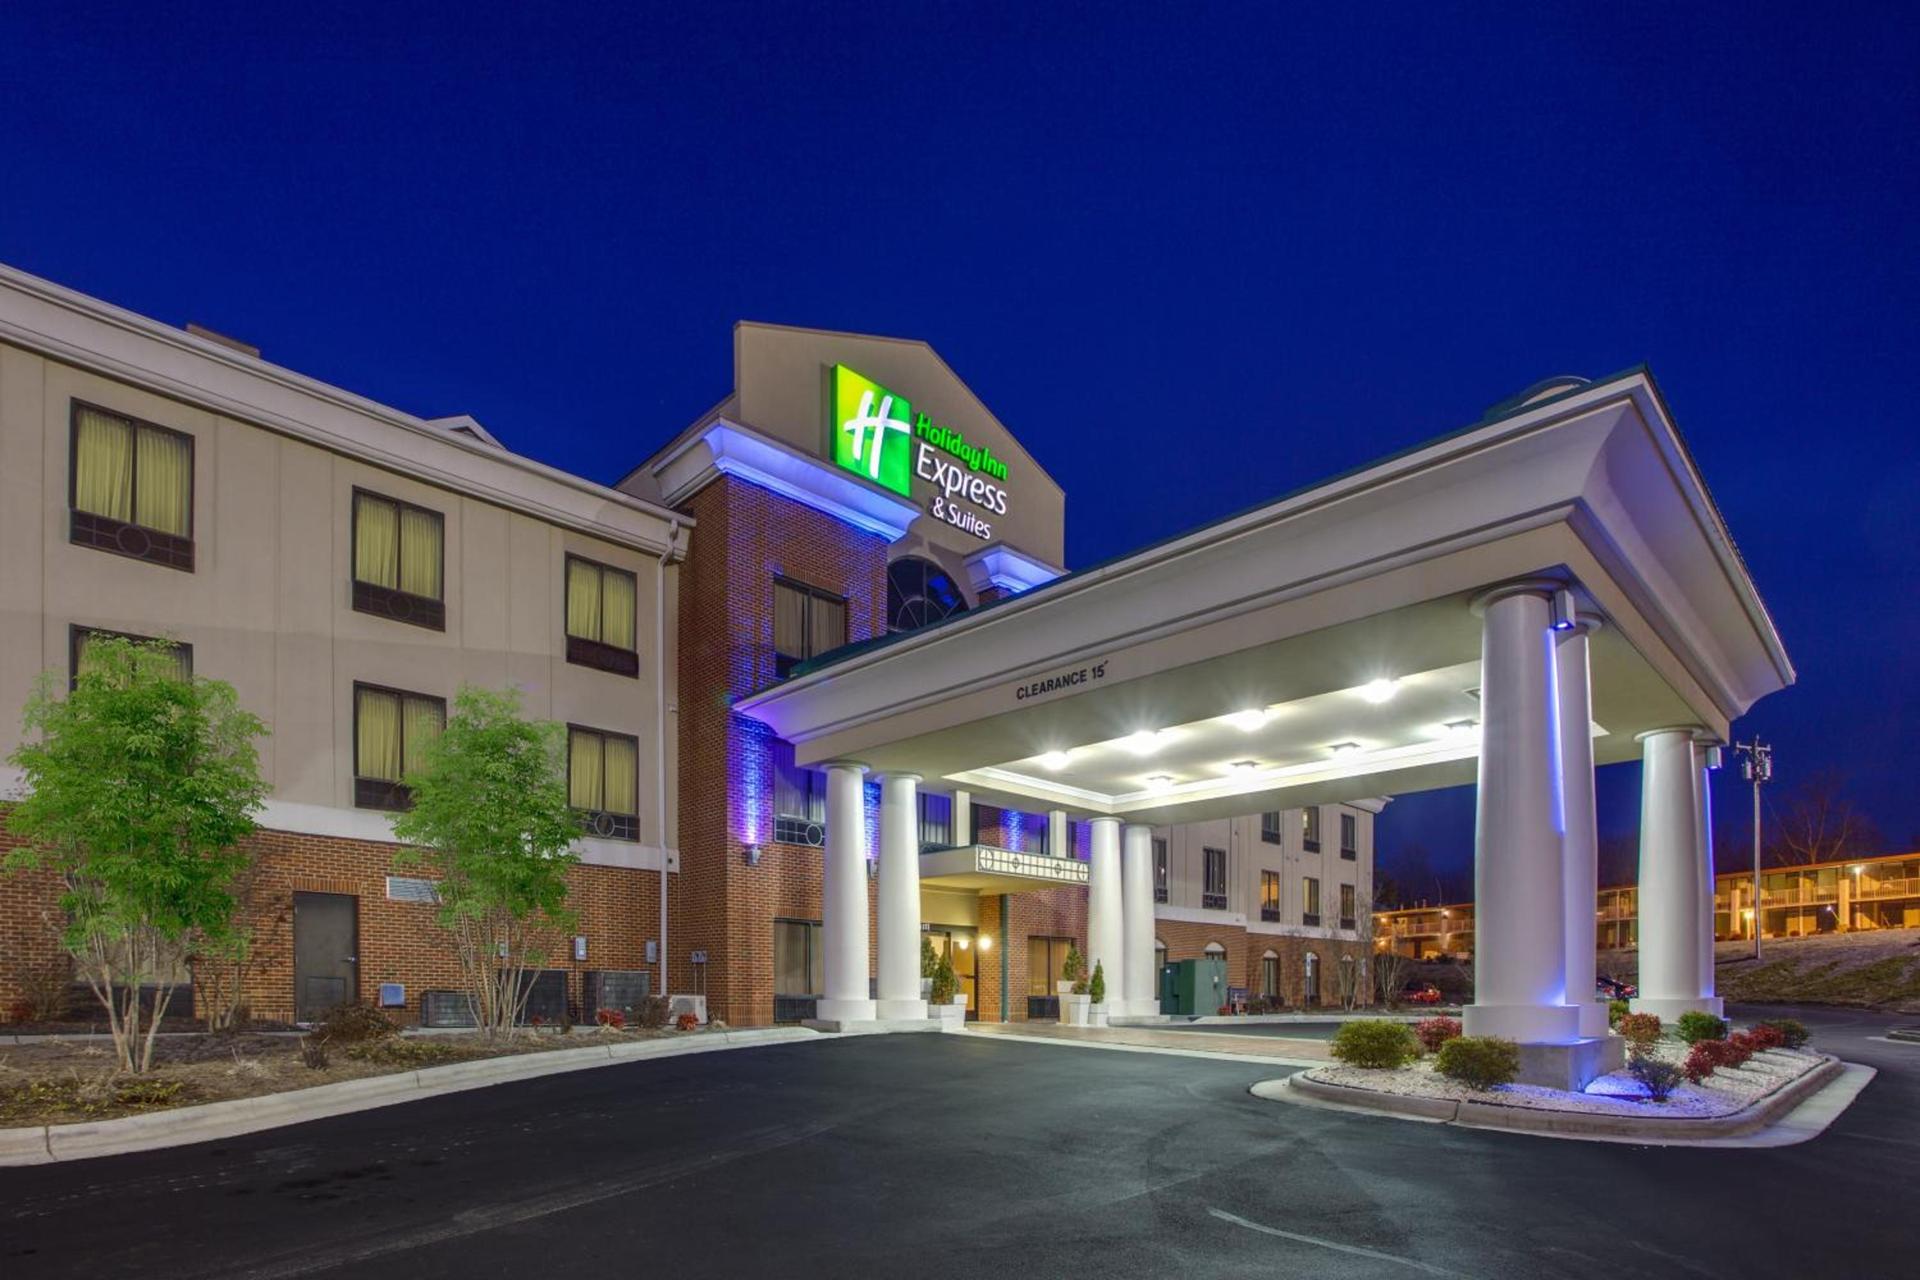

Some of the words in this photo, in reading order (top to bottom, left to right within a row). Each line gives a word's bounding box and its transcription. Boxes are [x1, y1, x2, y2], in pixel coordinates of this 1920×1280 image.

[916, 412, 981, 471] Holiday
[982, 448, 1008, 481] Inn
[917, 443, 1007, 515] Express
[933, 497, 945, 520] &
[947, 504, 991, 540] Suites
[1016, 668, 1088, 700] CLEARANCE
